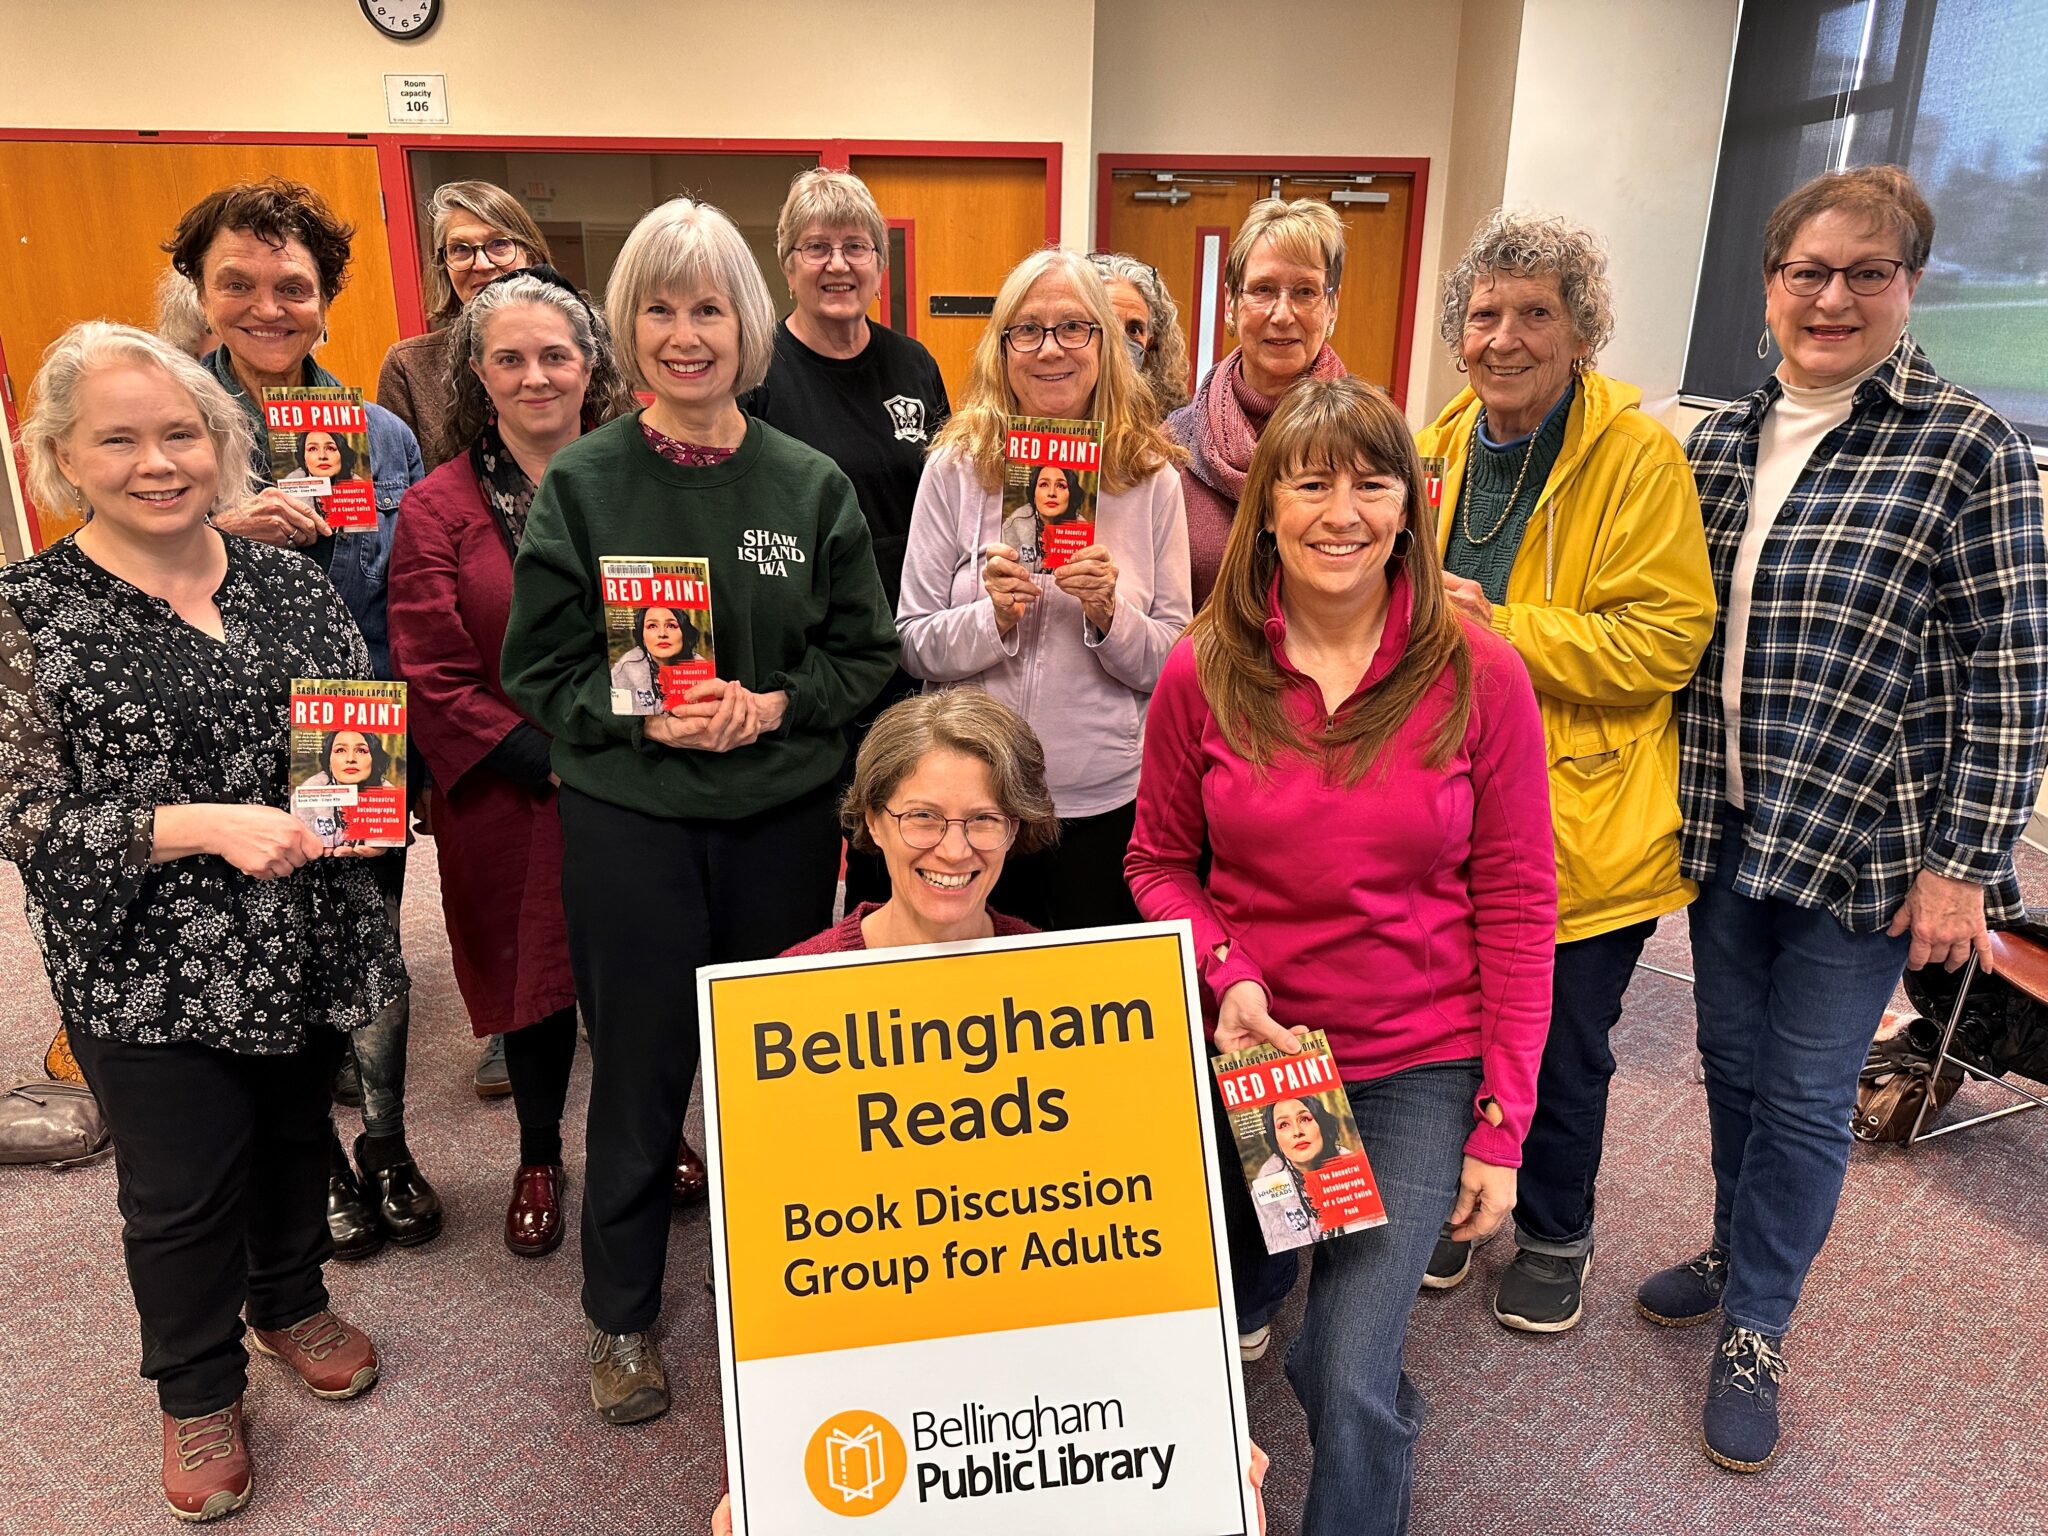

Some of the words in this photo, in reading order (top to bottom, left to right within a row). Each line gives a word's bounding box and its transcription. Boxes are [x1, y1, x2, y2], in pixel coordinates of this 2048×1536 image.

[377, 7, 386, 15] 8
[420, 2, 427, 10] 4
[388, 16, 396, 25] 7
[401, 20, 409, 28] 6
[413, 14, 421, 22] 5
[406, 102, 429, 112] 106
[268, 406, 303, 426] RED
[311, 406, 360, 426] PAINT
[1010, 436, 1040, 459] RED
[1048, 440, 1098, 463] PAINT
[744, 529, 797, 547] SHAW
[737, 546, 805, 562] ISLAND
[758, 561, 788, 577] WA
[606, 579, 642, 601] RED
[651, 579, 704, 602] PAINT
[296, 687, 320, 695] SASHA
[367, 690, 402, 698] LAPOINTE
[296, 701, 333, 724] RED
[344, 702, 402, 726] PAINT
[753, 997, 1156, 1081] Bellingham
[1219, 1060, 1243, 1072] SASHA
[1223, 1074, 1265, 1106] RED
[1271, 1054, 1333, 1094] PAINT
[857, 1076, 1069, 1152] Reads
[1258, 1183, 1290, 1198] WHATCOM
[1270, 1189, 1292, 1199] READS
[783, 1194, 902, 1242] Book
[916, 1170, 1153, 1227] Discussion
[783, 1252, 929, 1297] Group
[942, 1241, 1008, 1279] for
[1020, 1224, 1162, 1272] Adults
[912, 1395, 1124, 1454] Bellingham
[917, 1452, 1035, 1502] Public
[1038, 1443, 1176, 1491] Library
